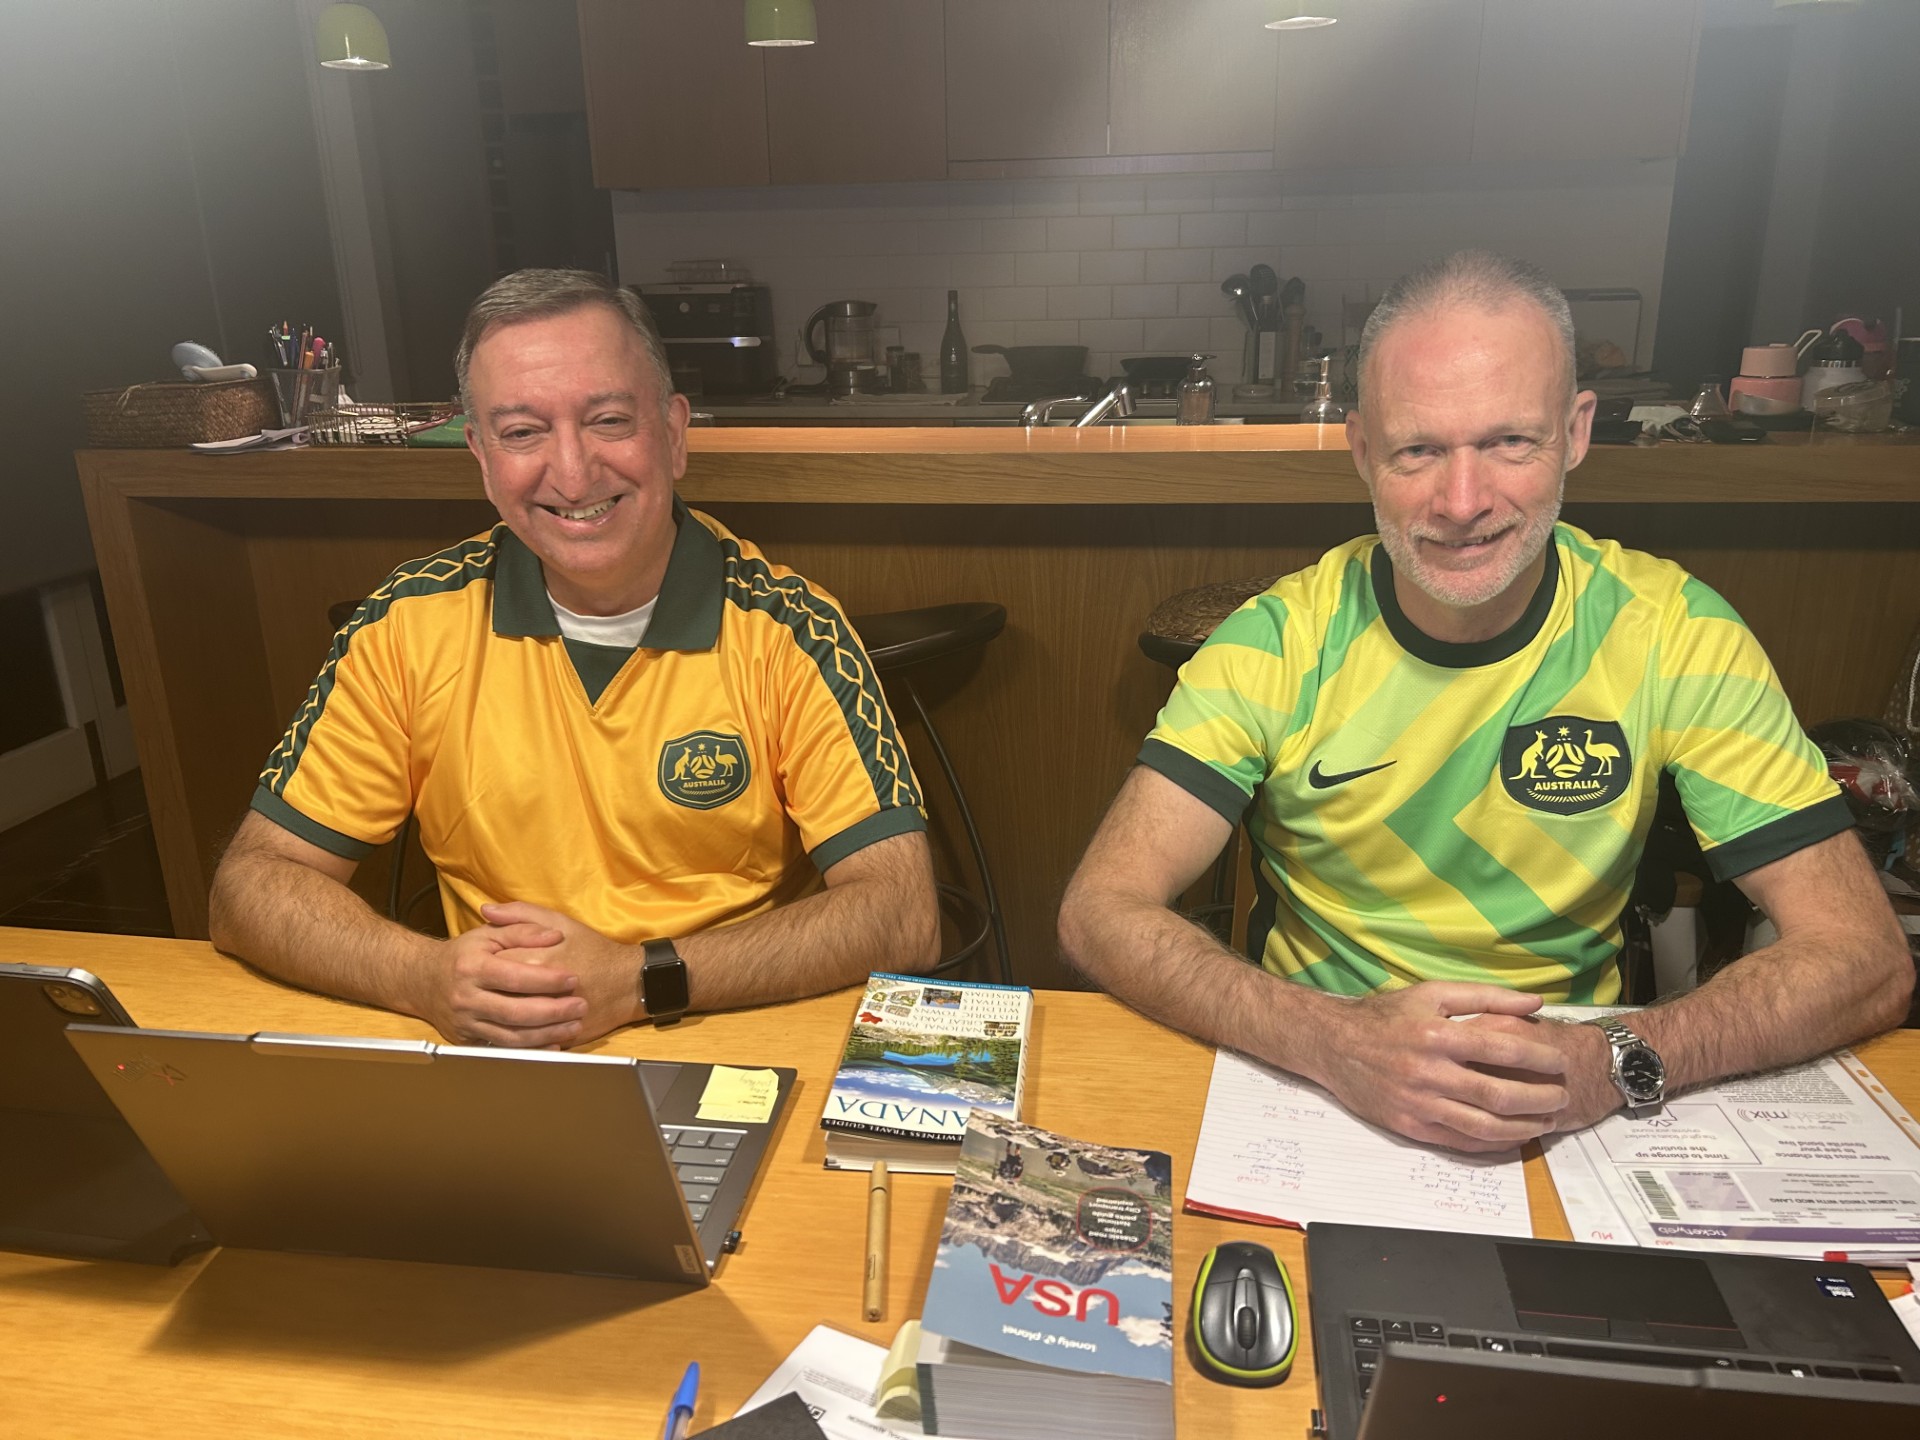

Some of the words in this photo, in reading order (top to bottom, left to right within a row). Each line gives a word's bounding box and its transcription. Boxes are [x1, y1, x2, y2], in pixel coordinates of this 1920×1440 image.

[683, 779, 726, 788] AUSTRALIA
[1534, 780, 1600, 790] AUSTRALIA
[964, 991, 1020, 999] MUSEUMS
[963, 998, 1020, 1006] FESTIVALS
[914, 1008, 956, 1016] TOWNS
[963, 1005, 1019, 1013] WILDLIFE
[913, 1015, 944, 1024] LAKES
[960, 1012, 1018, 1020] HISTORIC
[884, 1018, 918, 1029] PARKS
[954, 1019, 984, 1027] GREAT
[923, 1023, 981, 1033] NATIONAL
[836, 1096, 970, 1128] ANADA
[825, 1120, 865, 1129] GUIDES
[868, 1125, 905, 1136] TRAVEL
[910, 1131, 964, 1141] EWITNESS
[1635, 1151, 1649, 1159] up
[1651, 1151, 1690, 1159] change
[1089, 1202, 1124, 1211] transport
[1096, 1198, 1133, 1206] explained
[1097, 1218, 1130, 1226] National
[1658, 1226, 1728, 1237] ticketweb
[1108, 1234, 1138, 1242] Classic
[989, 1263, 1120, 1326] USA
[1002, 1325, 1041, 1342] planet
[1057, 1335, 1097, 1353] lonely
